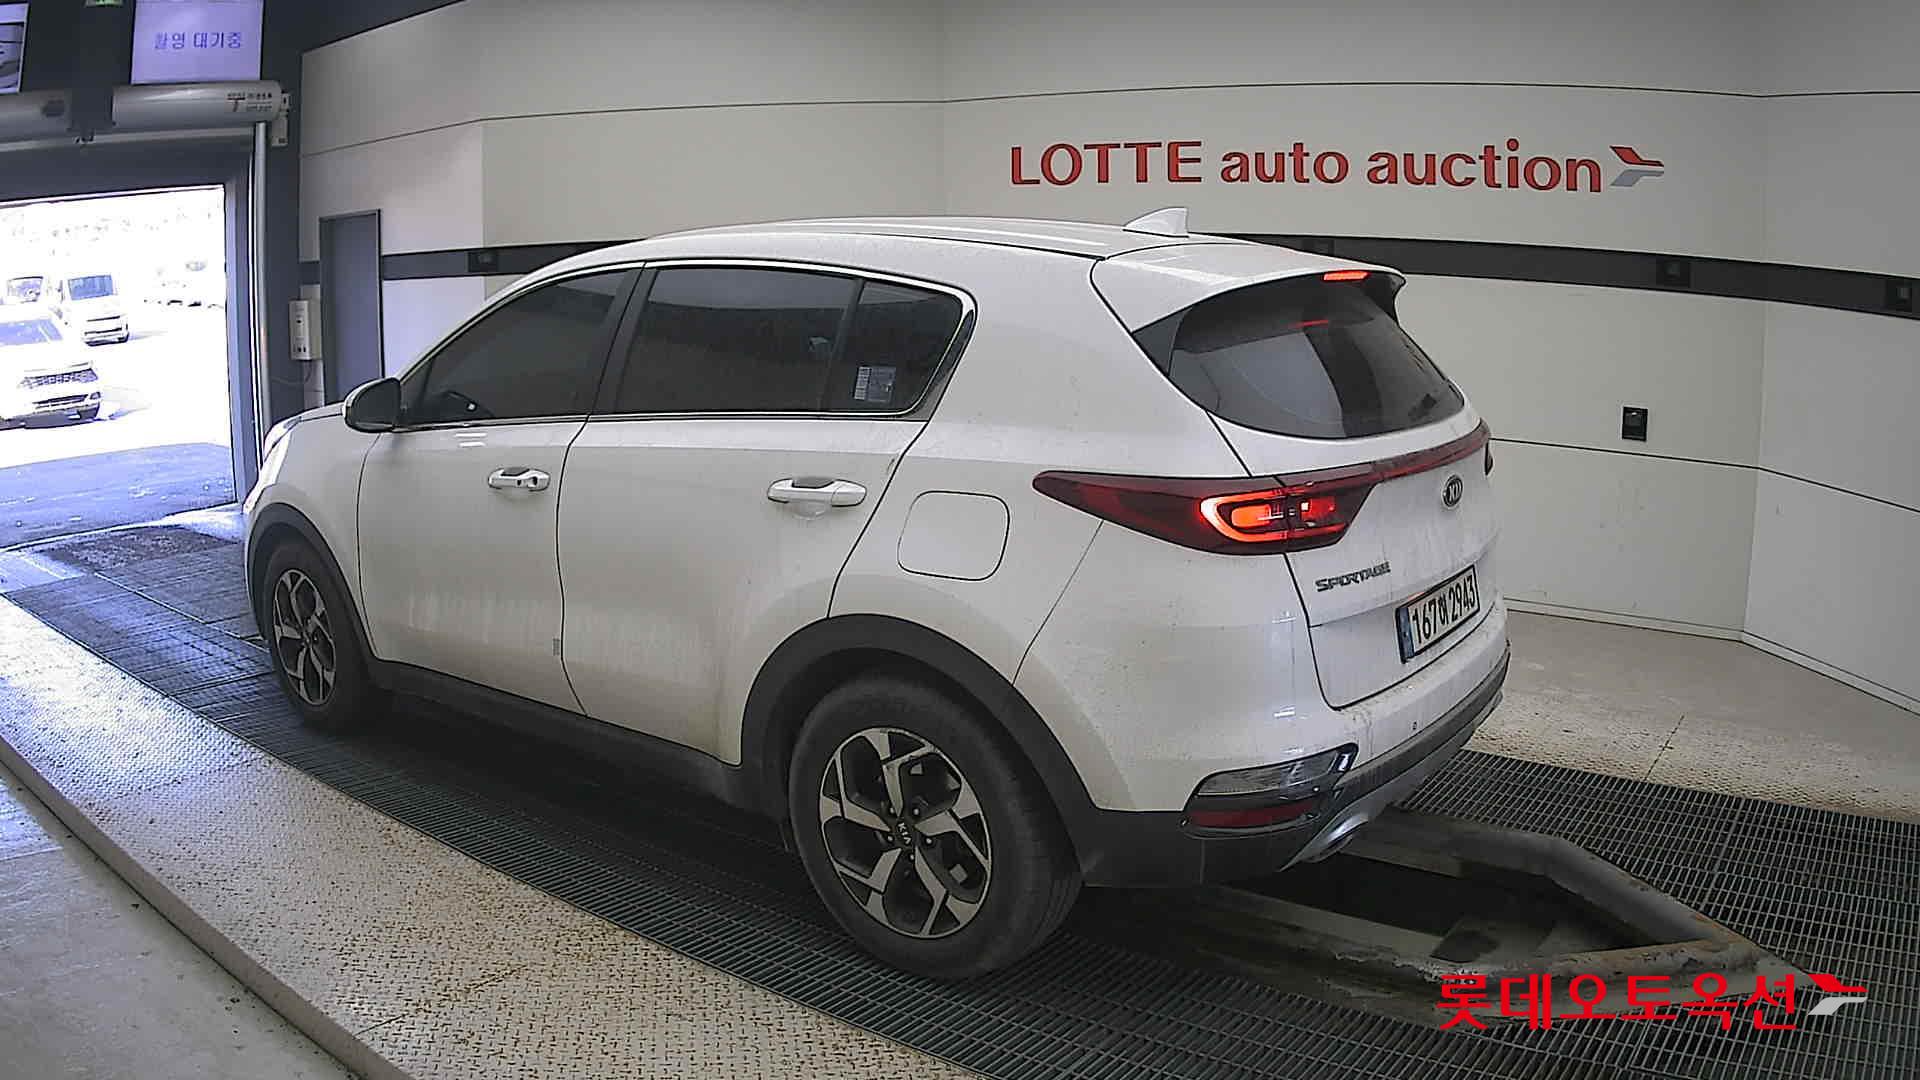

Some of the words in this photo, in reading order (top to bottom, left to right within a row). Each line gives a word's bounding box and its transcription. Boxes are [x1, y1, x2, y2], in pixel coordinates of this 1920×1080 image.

[193, 32, 241, 49] 대기중
[1011, 141, 1202, 185] LOTTE
[1220, 142, 1349, 184] auto
[1366, 139, 1602, 193] auction
[1315, 561, 1391, 592] SPORTAGE
